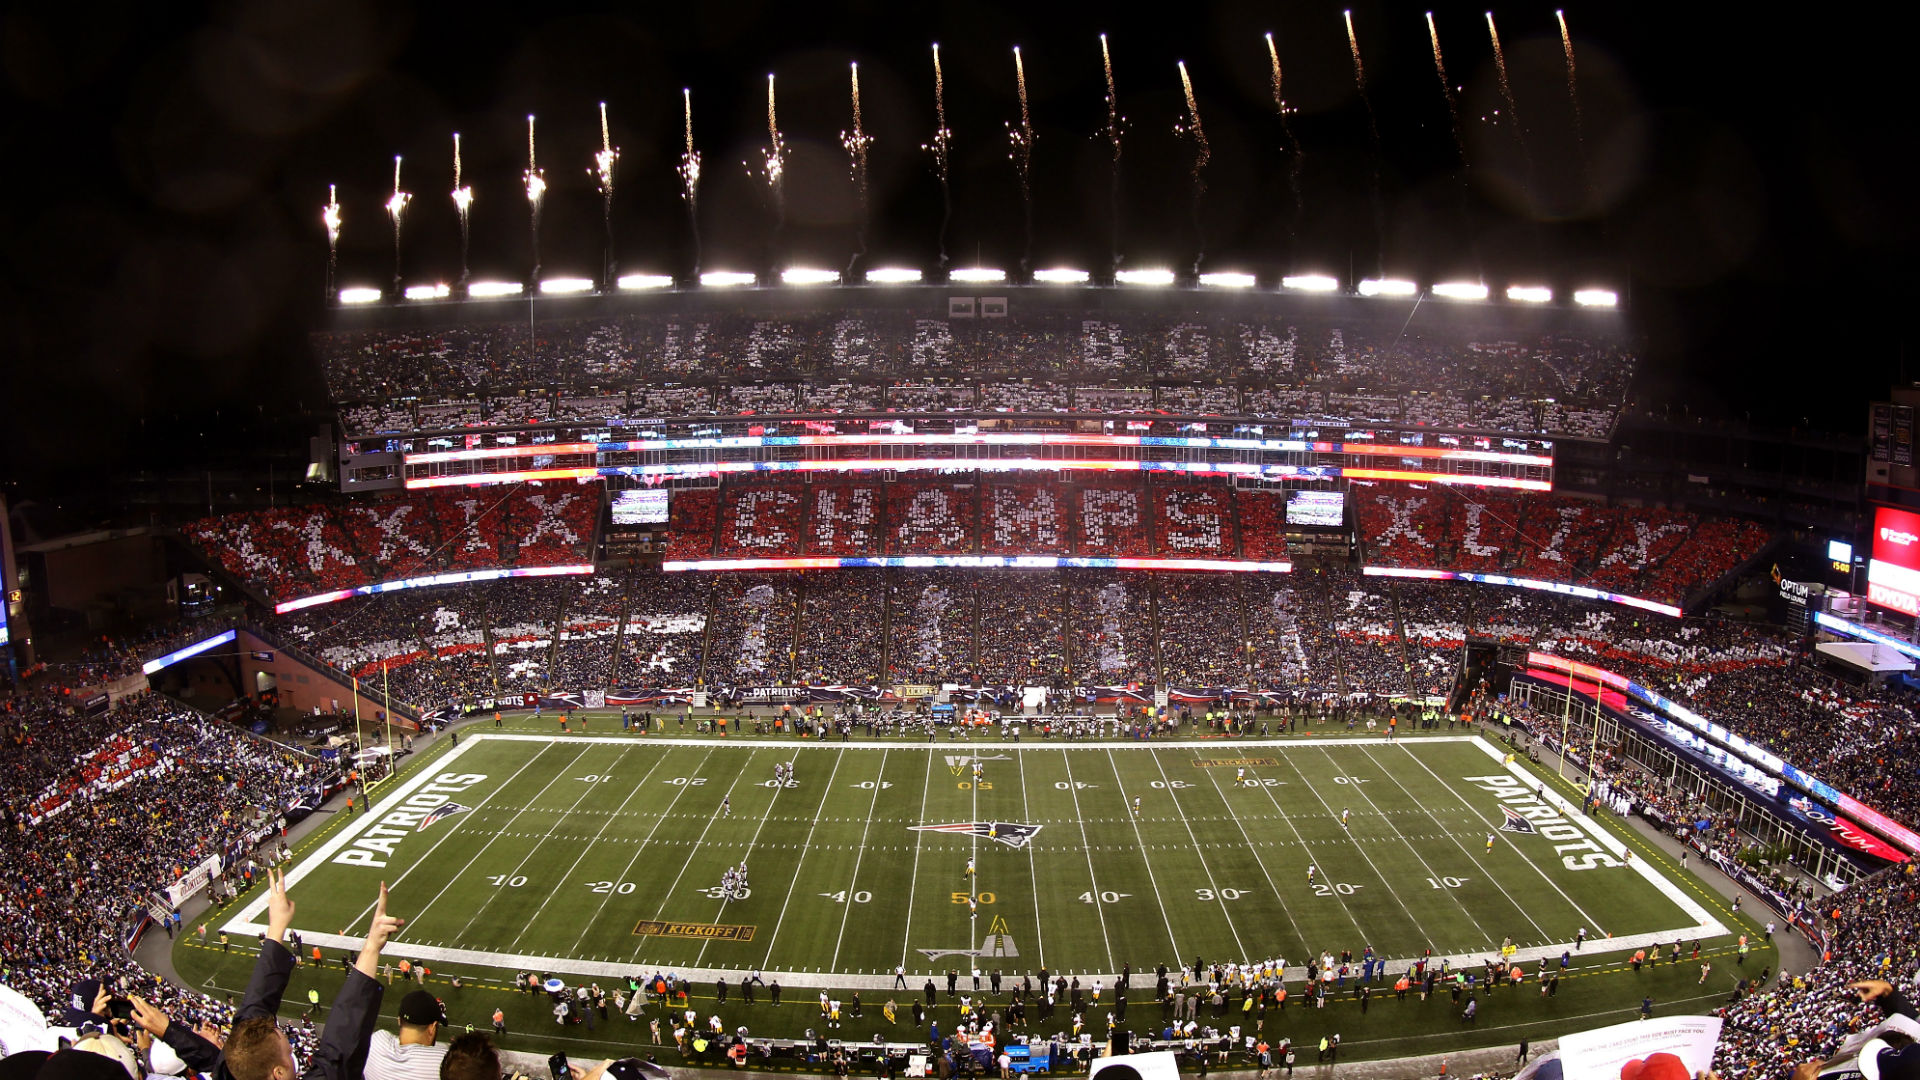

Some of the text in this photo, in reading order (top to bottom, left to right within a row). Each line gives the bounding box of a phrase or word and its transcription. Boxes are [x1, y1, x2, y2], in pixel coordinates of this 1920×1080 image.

[734, 488, 1221, 550] CHAMPS
[1781, 579, 1808, 597] OPTUM
[1870, 584, 1918, 613] TOYOTA
[753, 687, 801, 698] PATRIOTS
[957, 782, 993, 791] 50
[332, 772, 488, 868] PATRIOTS
[1463, 775, 1626, 871] PATRIOTS
[1806, 811, 1876, 851] OPTUM
[499, 874, 528, 888] 10
[592, 881, 636, 894] 20
[1427, 877, 1461, 889] 10
[1196, 888, 1241, 901] 30
[1312, 883, 1354, 897] 20
[831, 891, 872, 904] 40
[952, 892, 996, 905] 50
[1079, 891, 1120, 904] 40
[668, 925, 733, 937] KICKOFF
